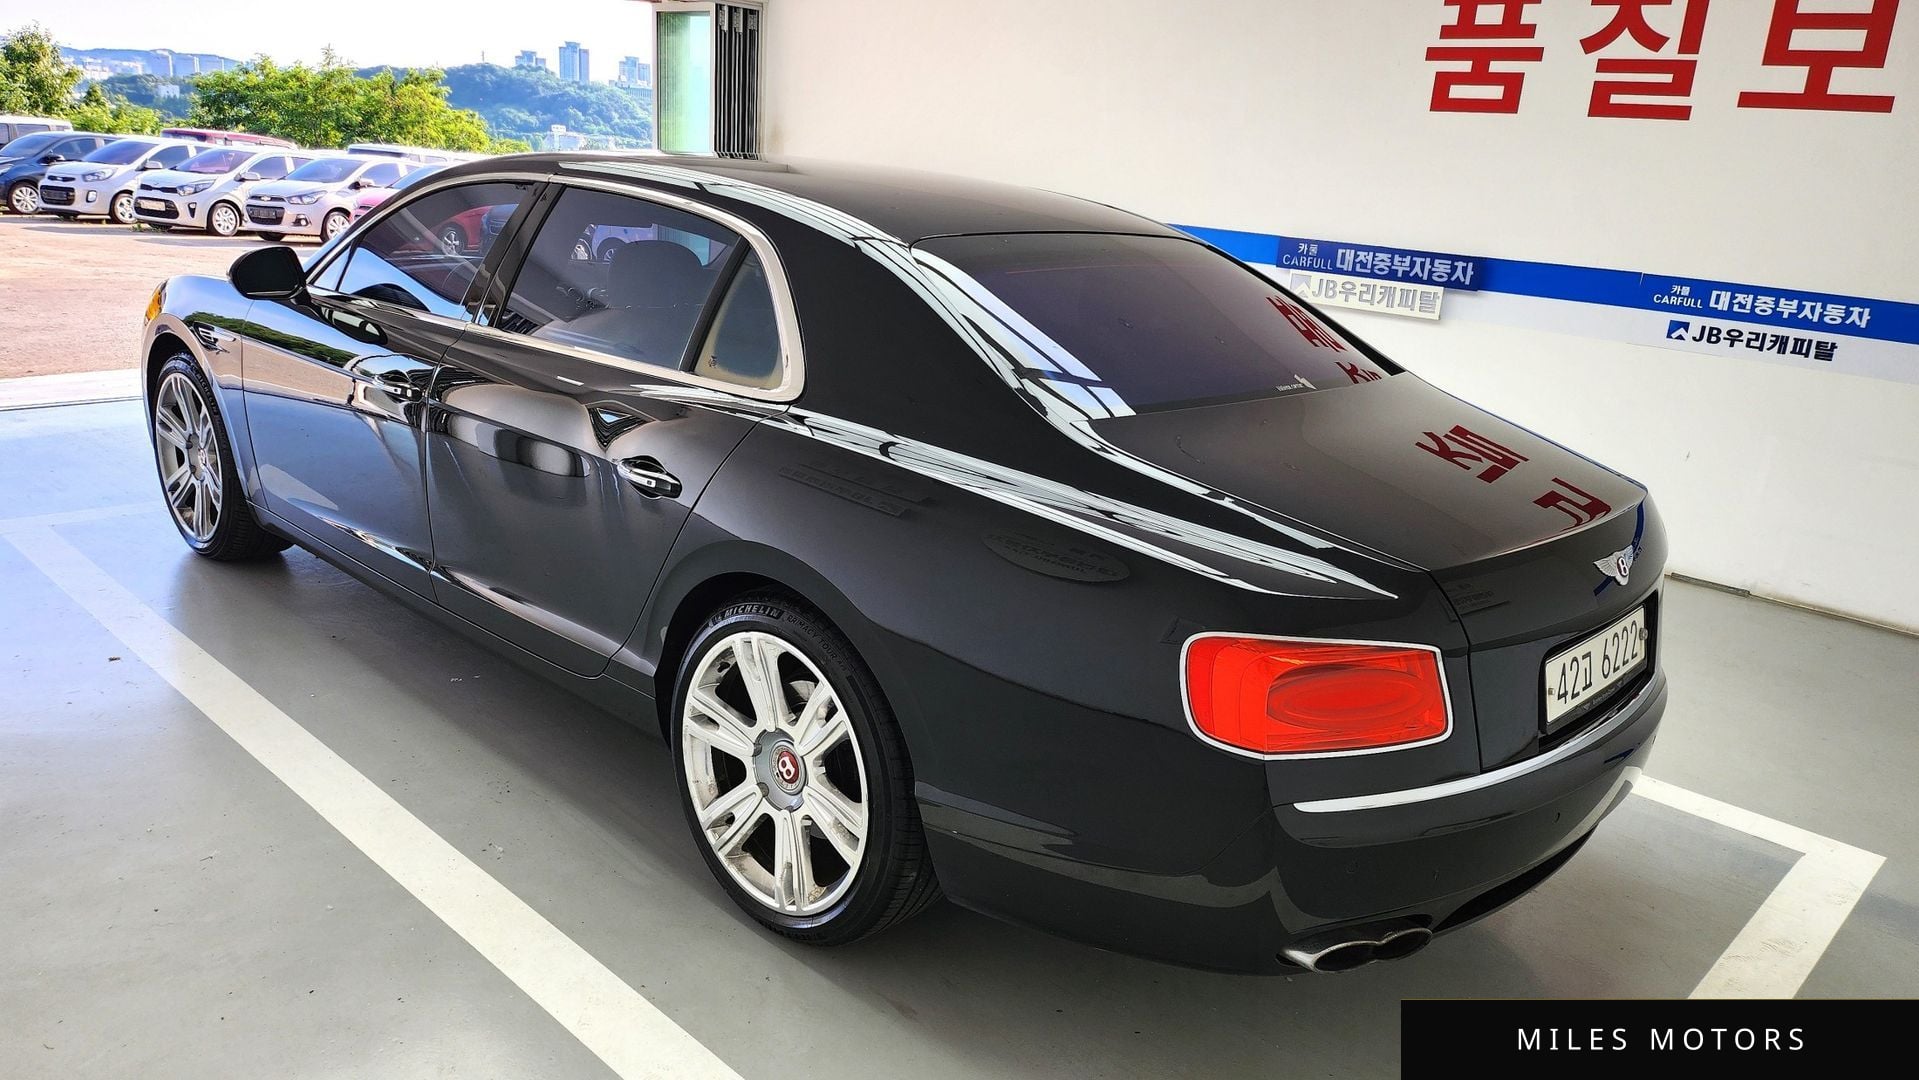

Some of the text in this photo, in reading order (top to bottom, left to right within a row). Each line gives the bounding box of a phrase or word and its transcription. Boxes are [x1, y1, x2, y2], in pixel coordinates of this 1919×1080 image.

[1283, 254, 1333, 271] CARFULL
[1335, 248, 1475, 285] 대전중부자동차
[1311, 278, 1441, 314] JB우리캐피탈
[1653, 294, 1703, 309] CARFULL
[1709, 290, 1872, 329] 대전중부자동차
[1691, 325, 1839, 362] JB우리캐피탈
[724, 604, 781, 618] MICHELIN
[1602, 620, 1638, 679] 6222
